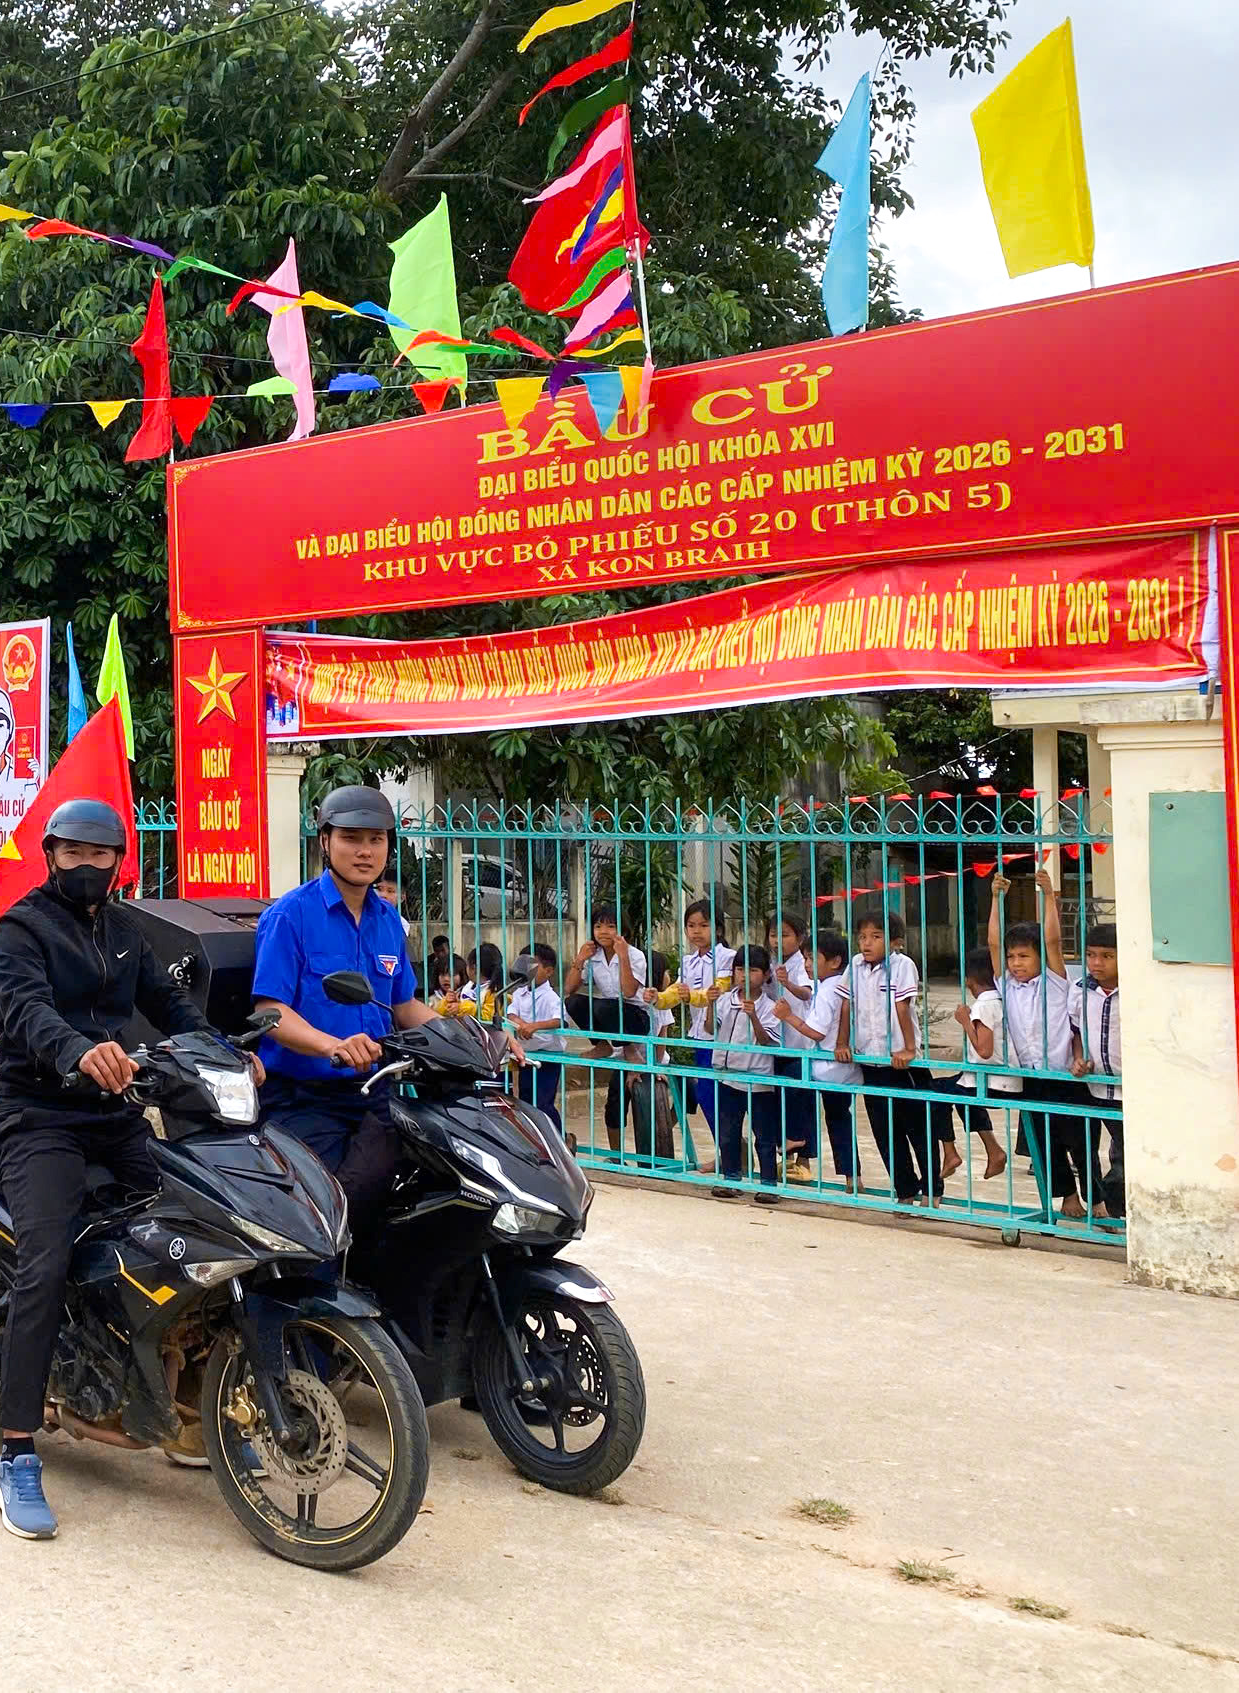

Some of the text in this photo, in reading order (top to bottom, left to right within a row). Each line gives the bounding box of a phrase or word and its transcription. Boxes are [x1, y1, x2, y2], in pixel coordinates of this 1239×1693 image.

[476, 363, 834, 465] BẦU CỬ
[295, 534, 321, 560] VÀ
[325, 531, 359, 558] ĐẠI
[364, 518, 411, 551] BIỂU
[417, 515, 452, 546] HỘI
[458, 507, 520, 539] ĐỒNG
[527, 497, 593, 529] NHÂN
[600, 488, 652, 519] DÂN
[659, 479, 711, 510] CÁC
[720, 466, 774, 503] CẤP
[782, 457, 877, 495] NHIỆM
[886, 446, 925, 481] KỲ
[934, 440, 1011, 475] 2026
[1044, 423, 1124, 460] 2031
[478, 421, 835, 500] ĐẠI BIỂU QUỐC HỘI KHÓA XVI
[363, 482, 1012, 581] KHU VỰC BỎ PHIẾU SỐ 20 (THÔN 5)
[537, 540, 771, 583] XÃ KON BRAIH
[820, 588, 866, 655] NHÂN
[865, 583, 903, 650] DÂN
[903, 581, 938, 651] CÁC
[942, 569, 975, 652] CẤP
[979, 573, 1034, 664] NHIỆM
[1038, 570, 1060, 647] KỲ
[1065, 580, 1110, 645] 2026
[1127, 578, 1171, 642] 2031
[201, 741, 232, 779] NGÀY
[199, 789, 242, 831] BẦU CỬ
[187, 846, 256, 891] LÀ NGÀY HỘI
